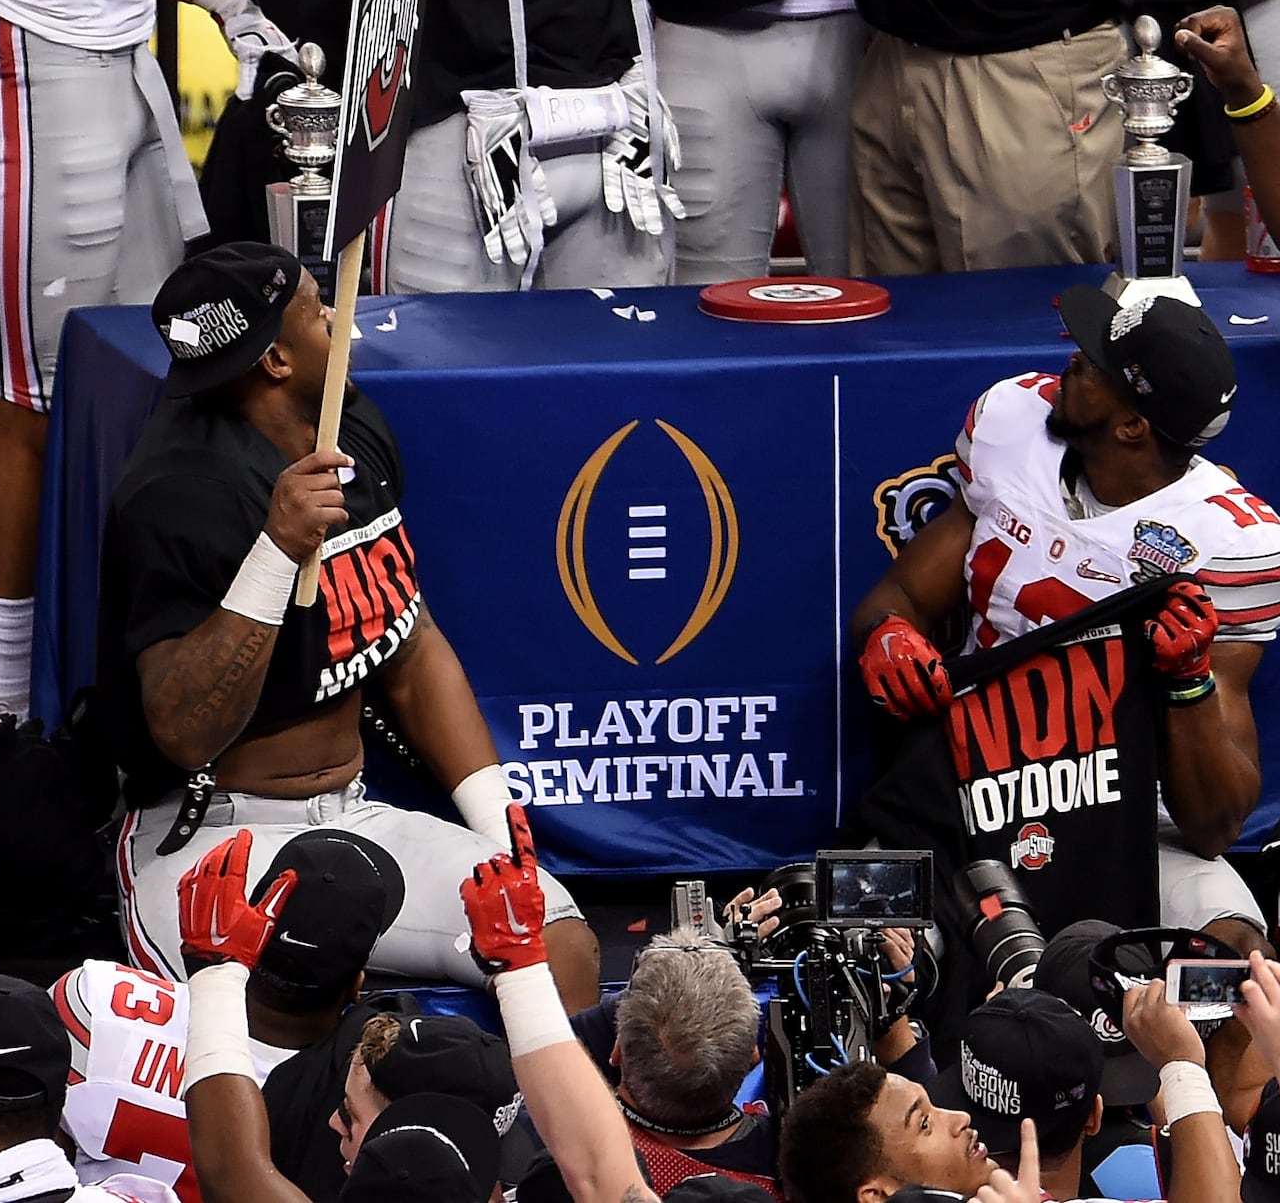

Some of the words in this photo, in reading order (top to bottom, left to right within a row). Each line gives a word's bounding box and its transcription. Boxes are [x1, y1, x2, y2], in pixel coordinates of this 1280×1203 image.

[196, 297, 241, 334] BOWL
[1140, 532, 1184, 563] Allstate
[318, 523, 417, 663] WO
[519, 696, 777, 750] PLAYOFF
[949, 639, 1125, 780] WON
[501, 752, 804, 807] SEMIFINAL
[958, 769, 1021, 836] NOT
[1021, 747, 1121, 819] DONE
[978, 1071, 1021, 1099] BOWL
